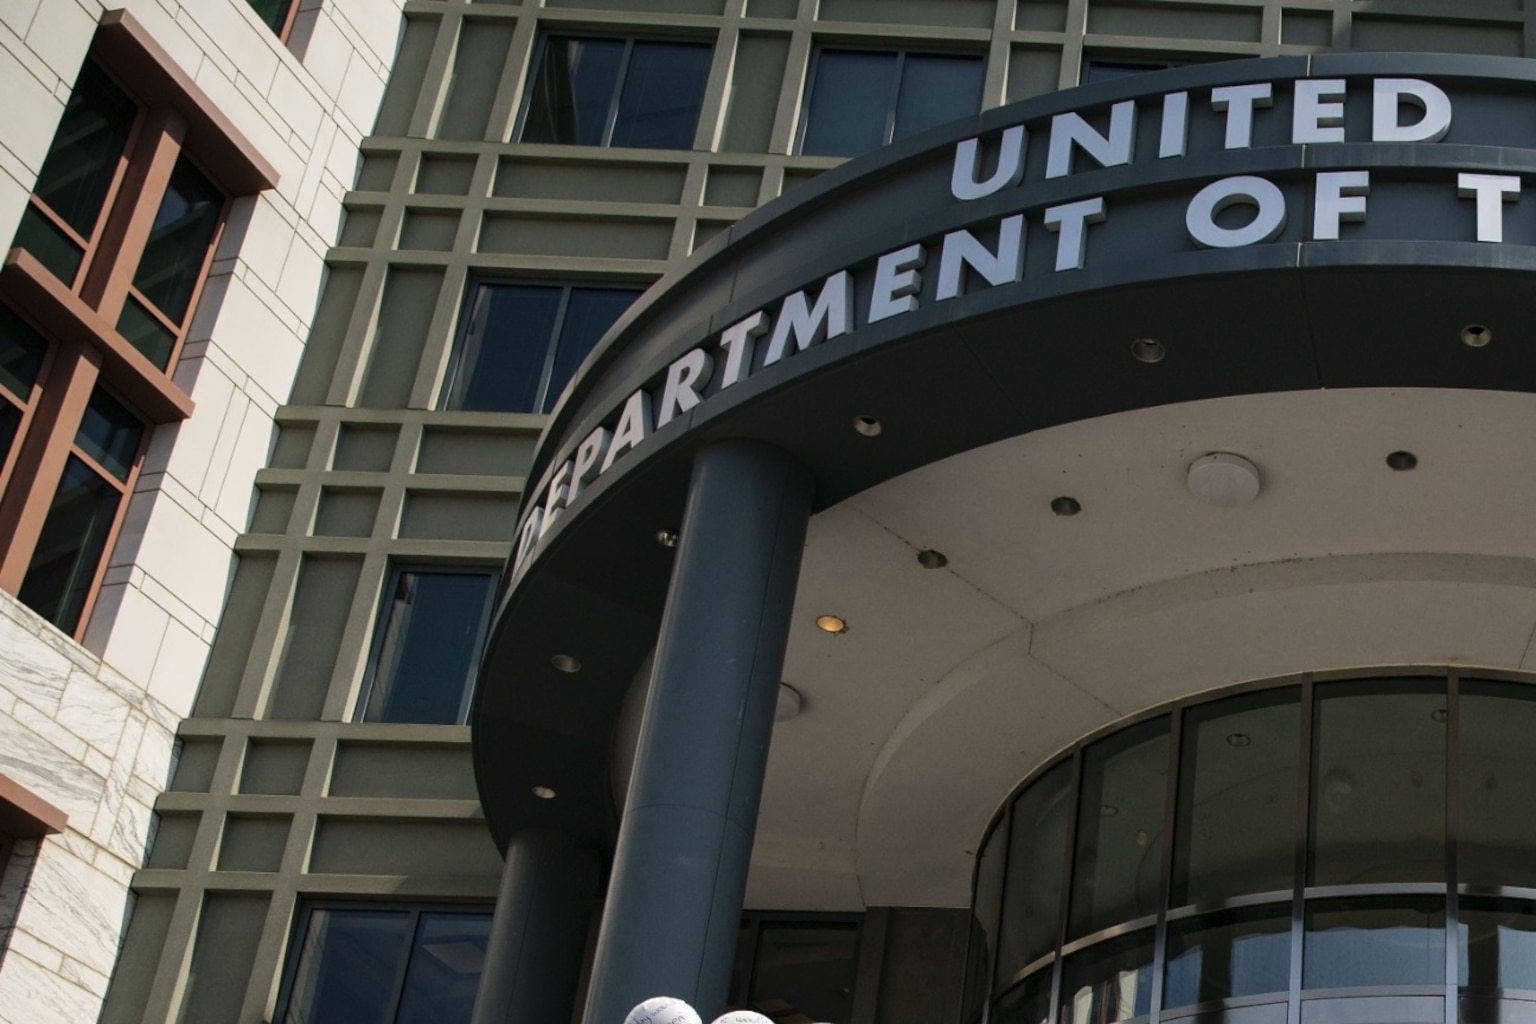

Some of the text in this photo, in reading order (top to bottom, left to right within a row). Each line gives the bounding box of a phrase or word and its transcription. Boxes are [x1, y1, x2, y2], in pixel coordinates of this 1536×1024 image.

[950, 77, 1452, 201] UNITED
[510, 195, 1107, 583] DEPARTMENT
[1184, 170, 1371, 249] OF
